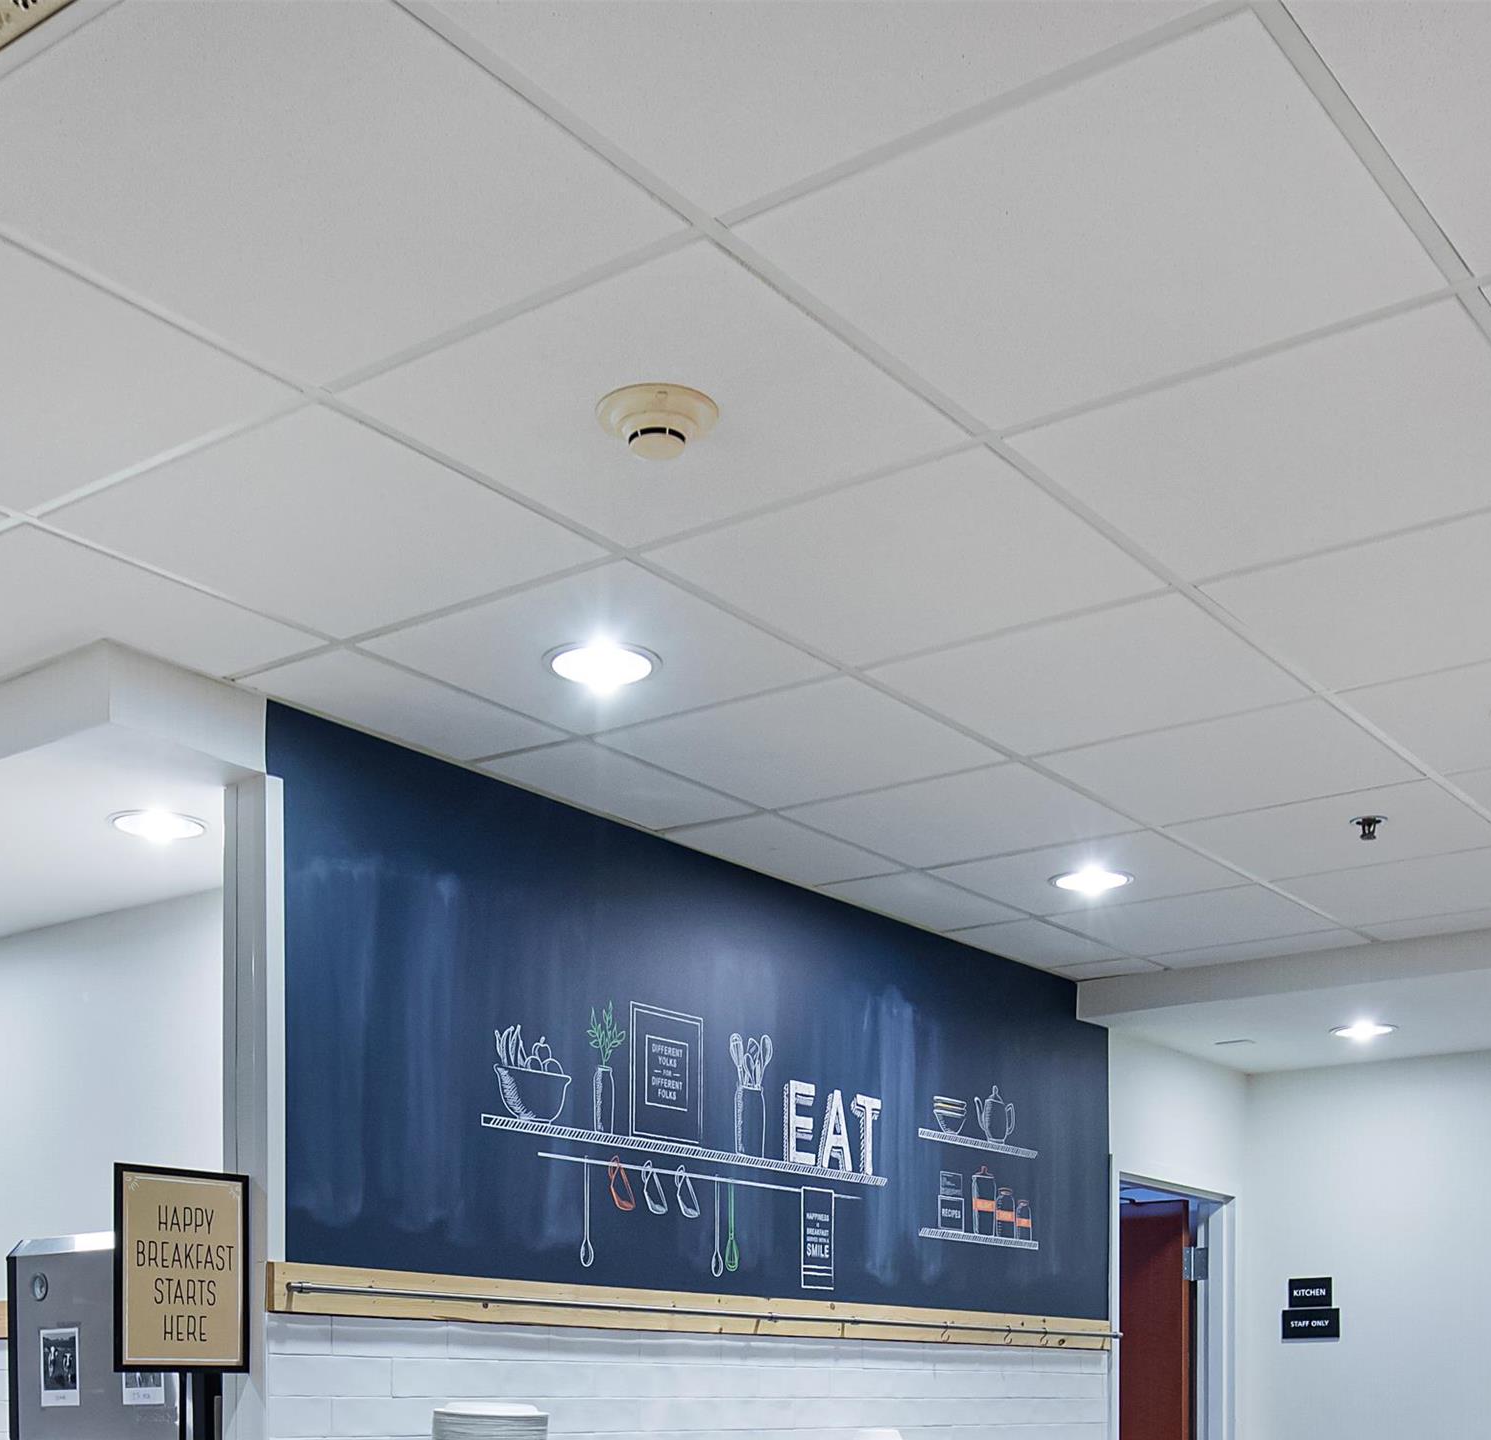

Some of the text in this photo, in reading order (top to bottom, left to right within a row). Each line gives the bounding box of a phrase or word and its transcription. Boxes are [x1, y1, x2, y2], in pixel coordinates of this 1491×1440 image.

[651, 1043, 683, 1058] DIFFERENT
[658, 1056, 677, 1068] YOLKS
[651, 1076, 683, 1090] DIFFERENT
[657, 1088, 677, 1101] FOLKS
[783, 1079, 882, 1176] EAT
[157, 1204, 215, 1234] HAPPY
[941, 1208, 961, 1219] RECIPES
[136, 1239, 234, 1271] BREAKFAST
[806, 1243, 830, 1258] SMILE
[153, 1277, 217, 1306] STARTS
[1293, 1288, 1326, 1297] KITCHEN
[163, 1314, 208, 1342] HERE
[1290, 1319, 1330, 1328] STAFF ONLY
